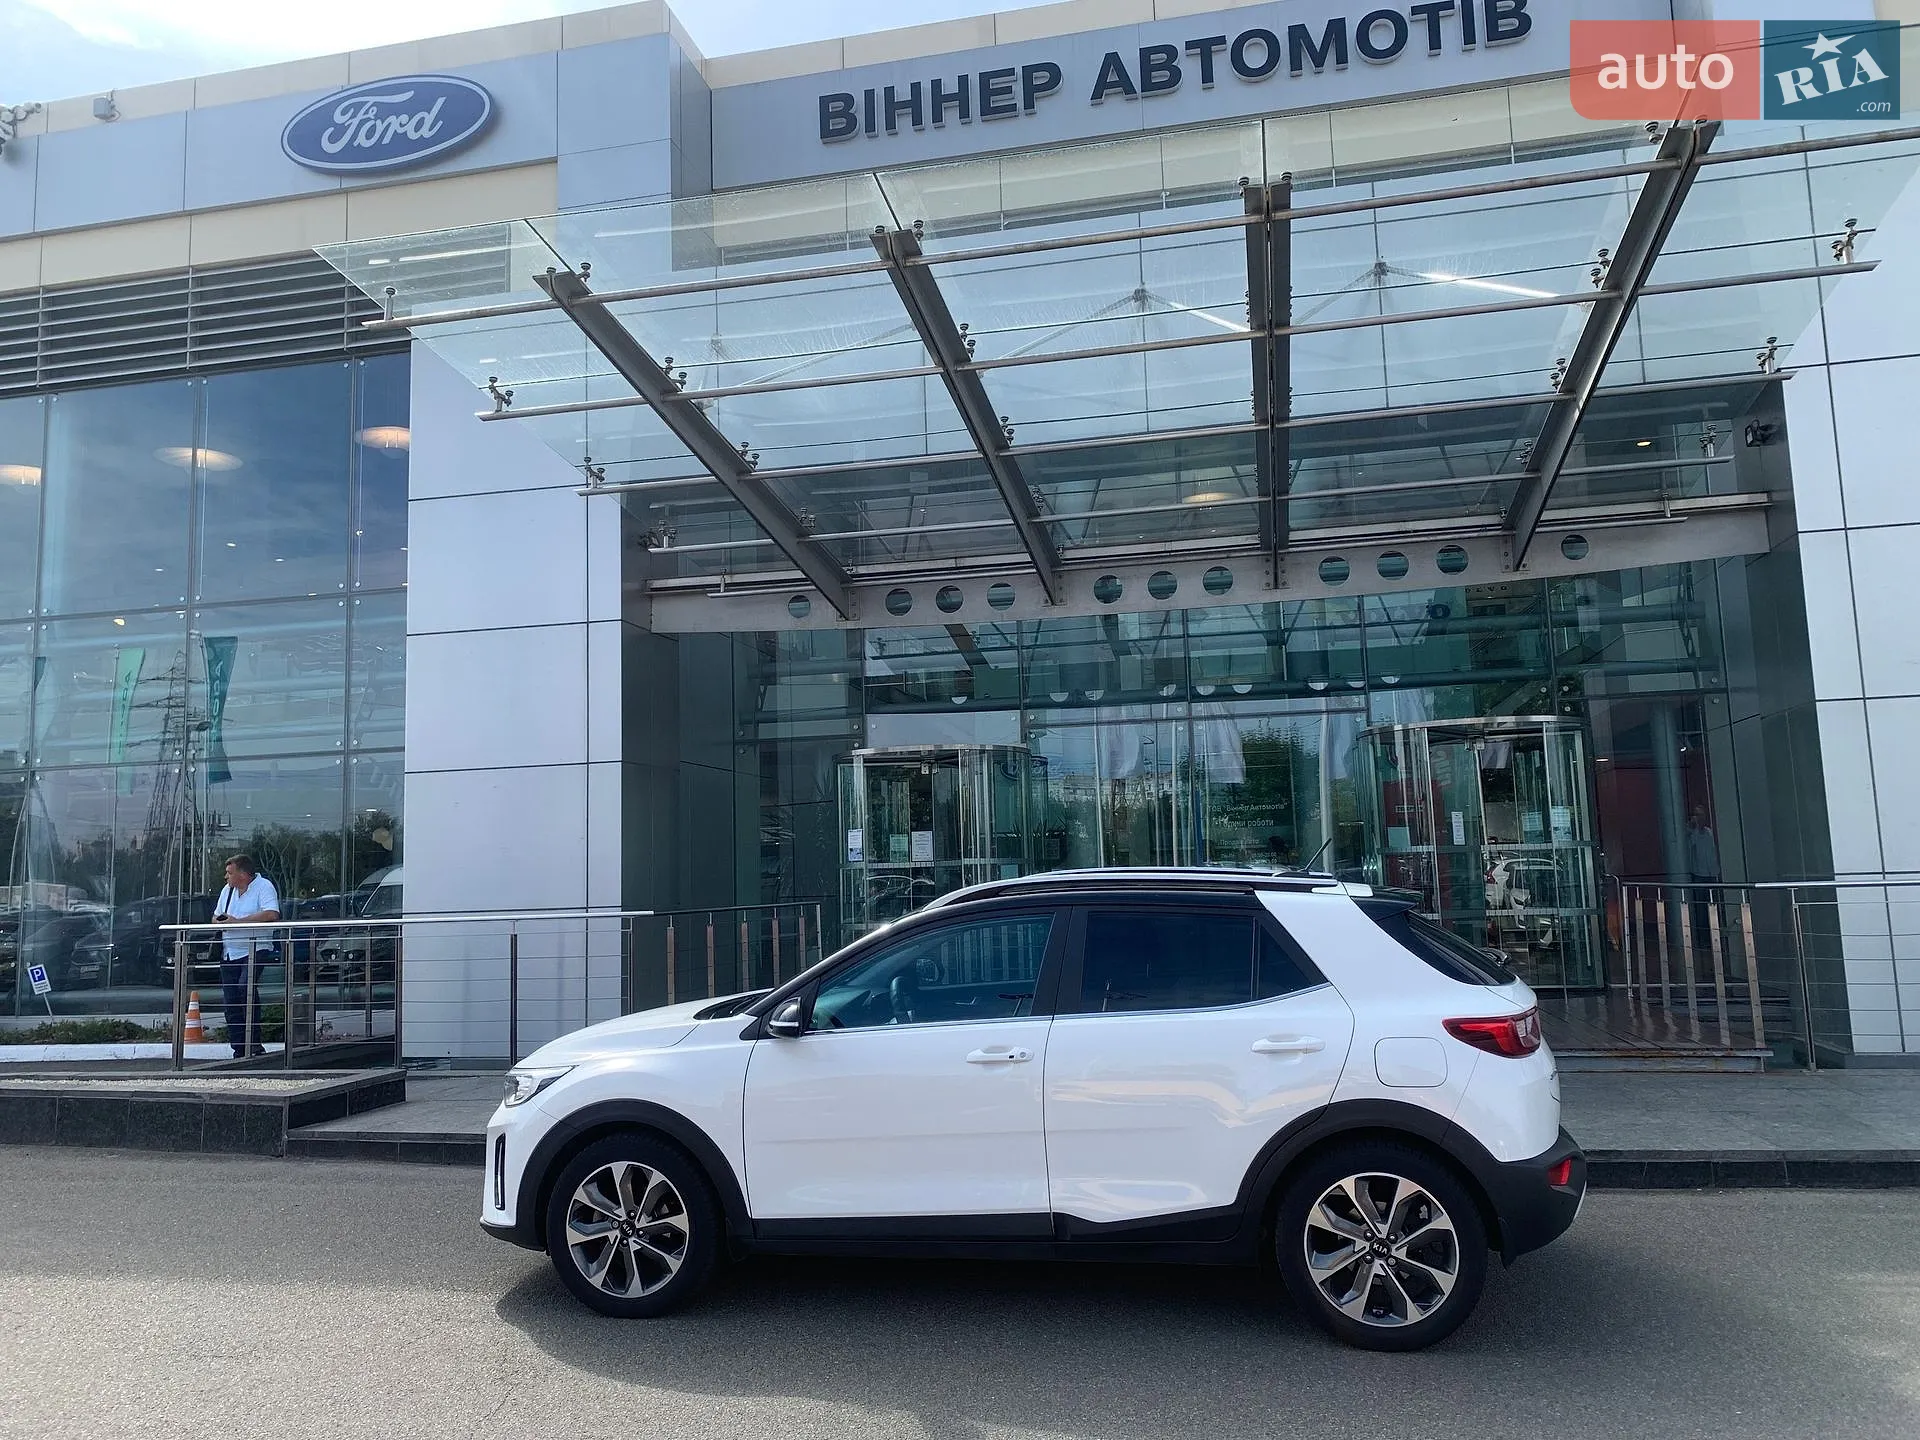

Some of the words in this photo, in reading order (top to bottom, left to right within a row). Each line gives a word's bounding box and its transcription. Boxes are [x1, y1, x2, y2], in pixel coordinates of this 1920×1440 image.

[818, 61, 1063, 143] ВІННЕР
[1090, 0, 1533, 106] АВТОМОТІВ
[320, 90, 446, 154] Ford
[1372, 1242, 1387, 1254] KIA
